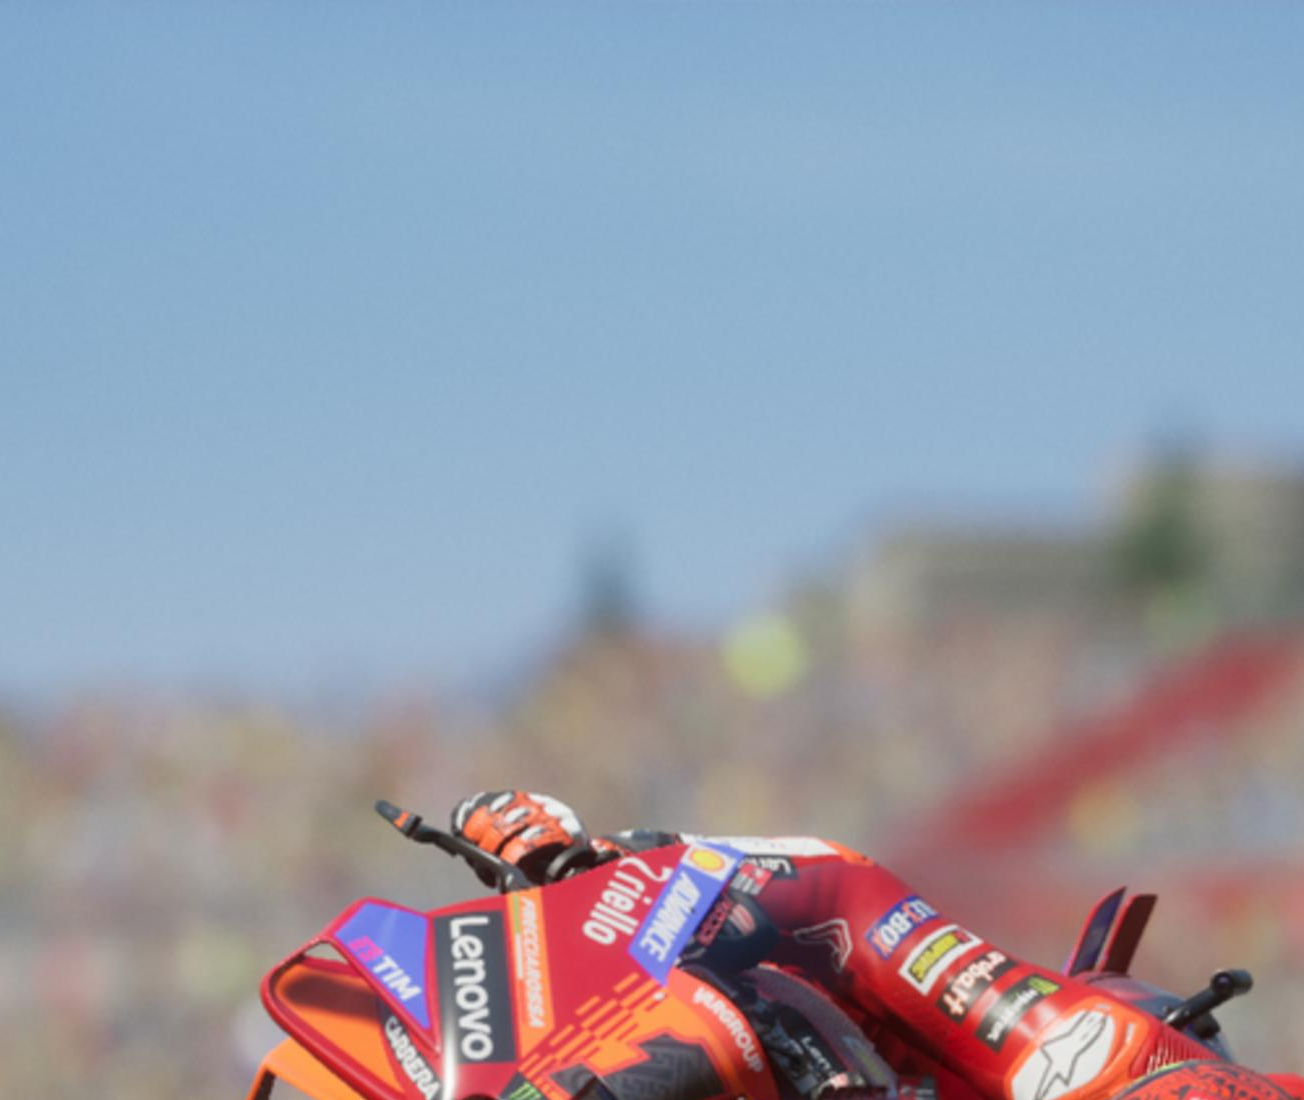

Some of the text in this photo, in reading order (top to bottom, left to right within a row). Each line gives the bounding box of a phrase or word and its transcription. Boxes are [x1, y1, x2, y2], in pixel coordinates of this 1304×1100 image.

[582, 870, 652, 945] riello
[372, 955, 422, 1002] TIM
[450, 915, 494, 1061] Lenovo
